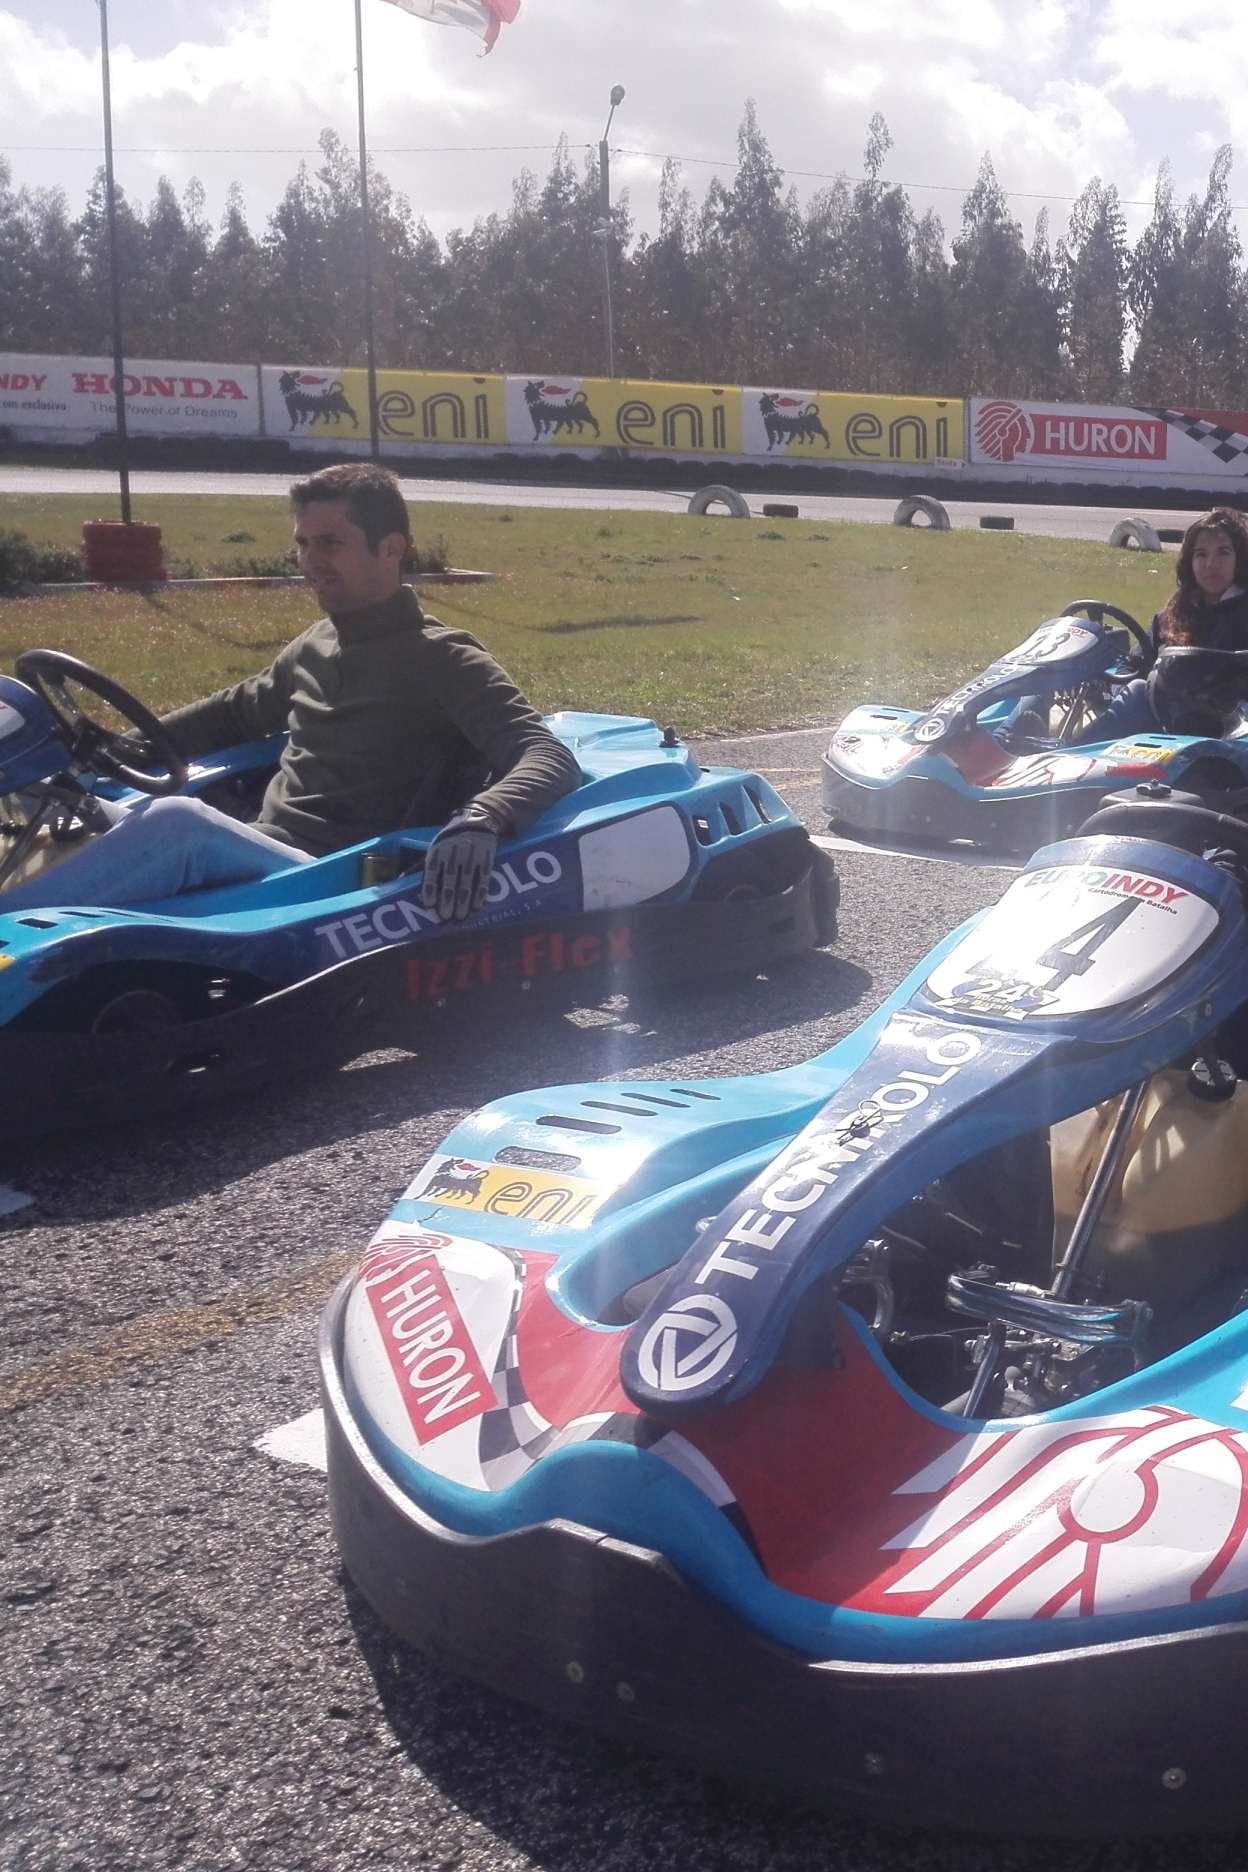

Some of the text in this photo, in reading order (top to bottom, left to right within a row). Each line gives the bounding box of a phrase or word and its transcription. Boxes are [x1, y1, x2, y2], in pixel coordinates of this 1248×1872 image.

[71, 372, 249, 400] HONDA
[91, 401, 116, 413] The
[184, 406, 238, 419] Dreams
[377, 377, 488, 439] eni
[617, 388, 726, 449] eni
[845, 401, 947, 459] eni
[1045, 420, 1156, 455] HURON
[314, 851, 562, 960] TECNOLO
[1024, 868, 1190, 904] EUOINDY
[705, 1030, 983, 1283] TECNIROLO
[483, 1181, 598, 1225] eni
[380, 1272, 481, 1425] HURON
